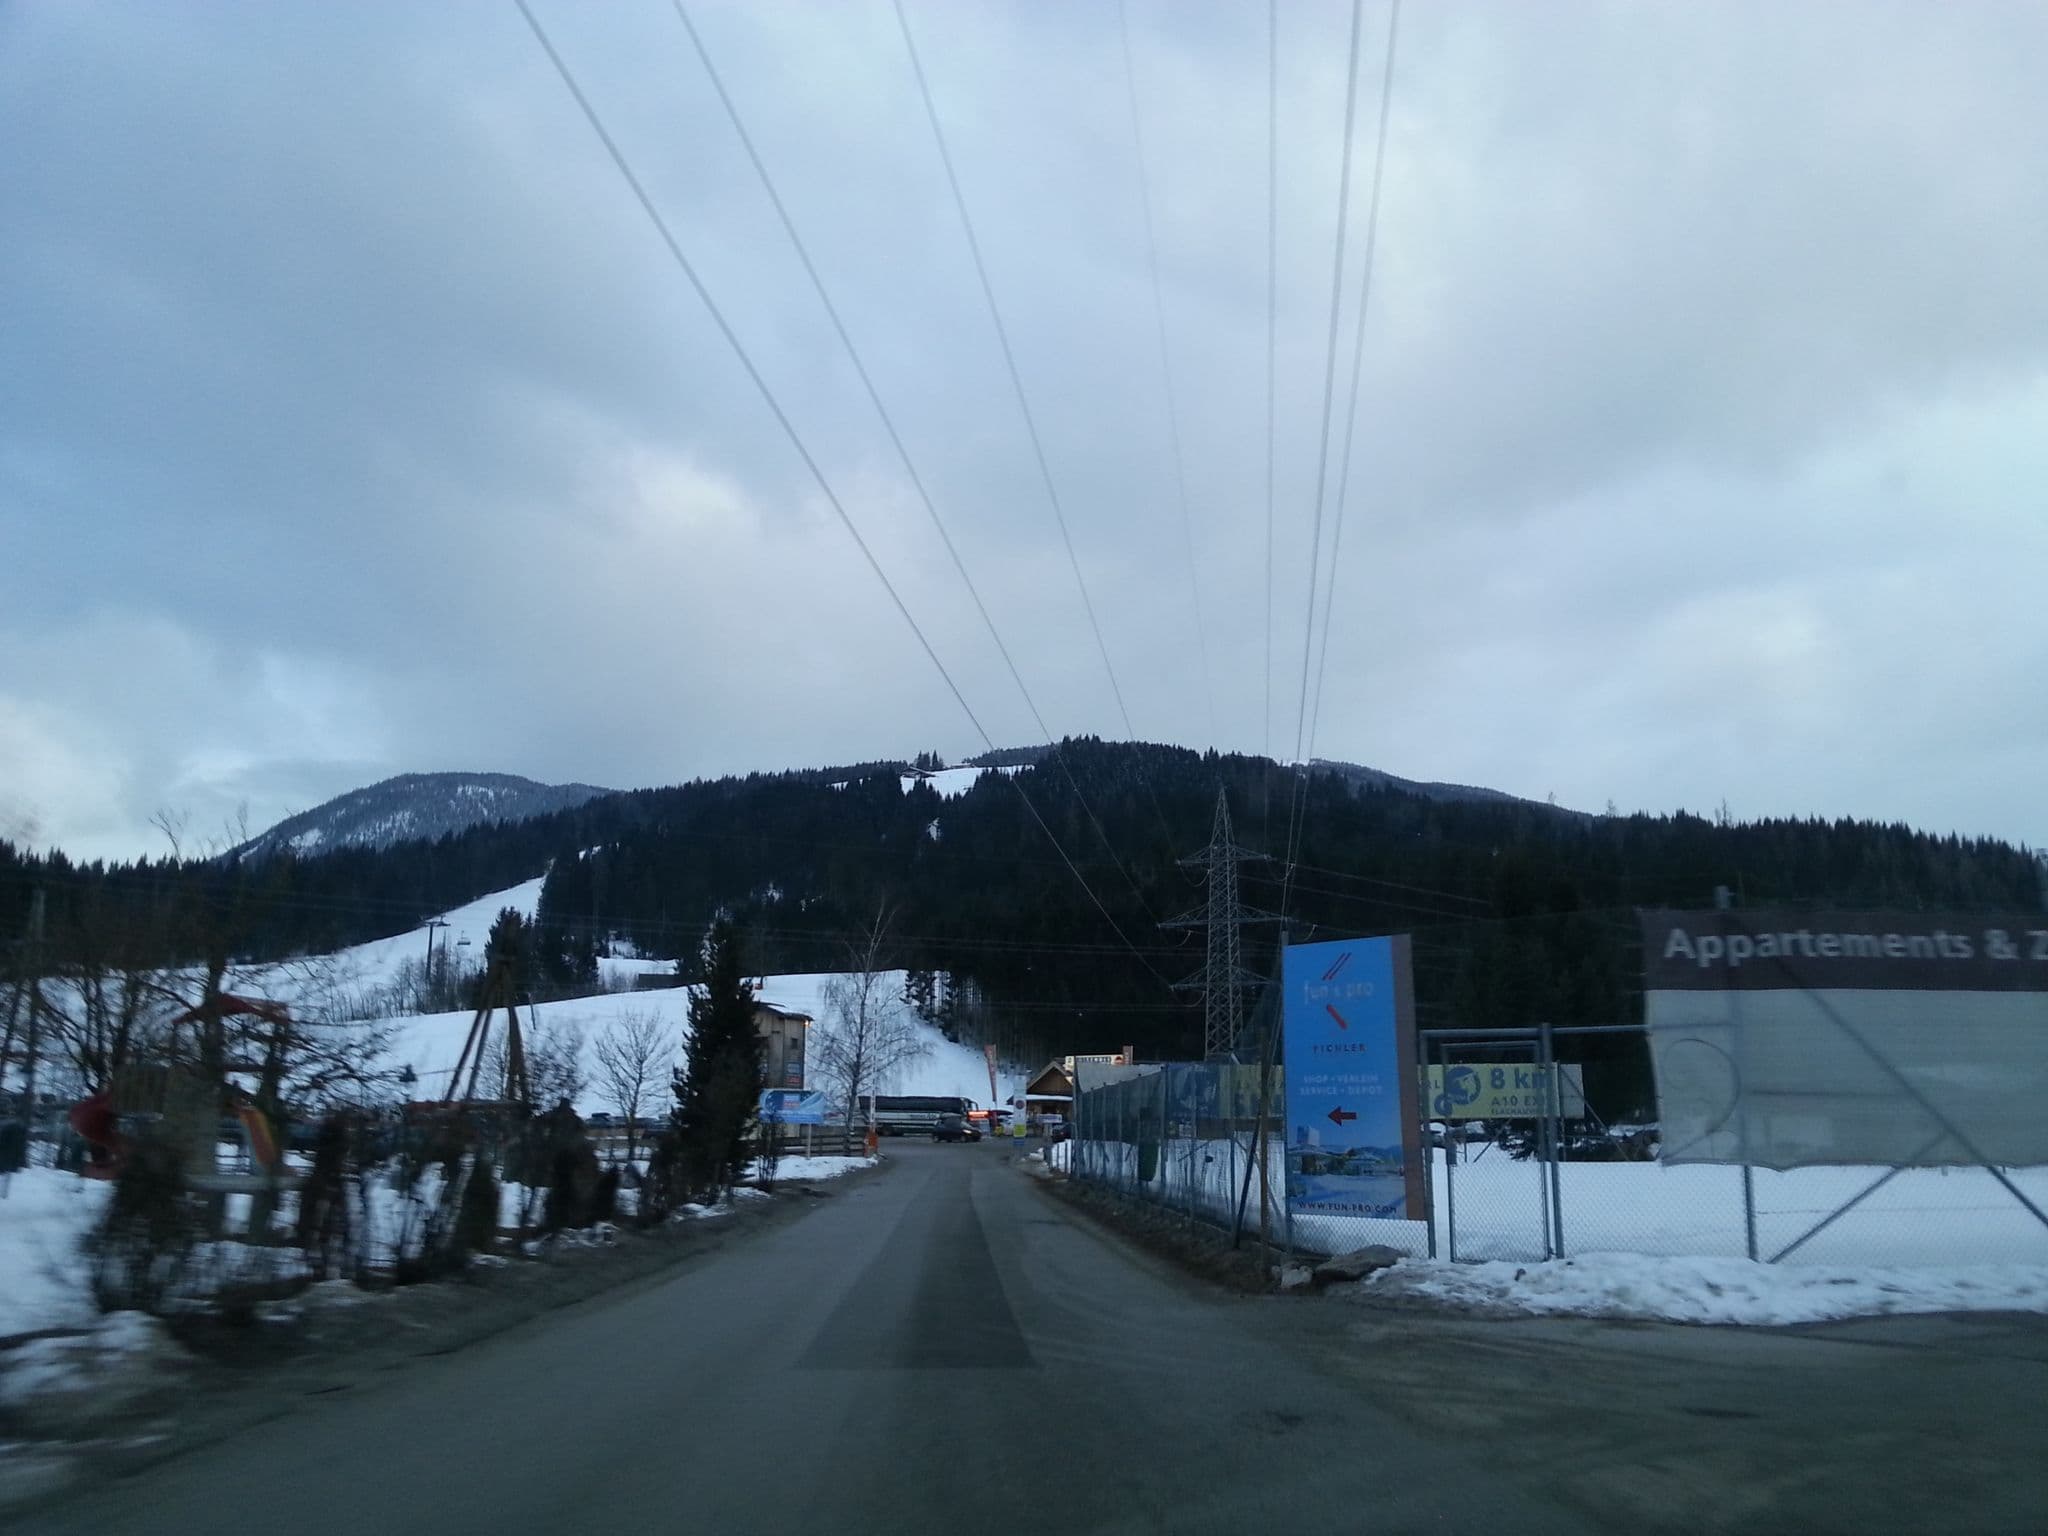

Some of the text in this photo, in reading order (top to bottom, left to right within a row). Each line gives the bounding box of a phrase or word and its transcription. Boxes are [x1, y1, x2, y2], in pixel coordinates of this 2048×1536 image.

[1662, 927, 1975, 967] Appartements
[1981, 928, 2018, 961] &
[1490, 1067, 1505, 1089] 8
[1491, 1095, 1518, 1106] A10
